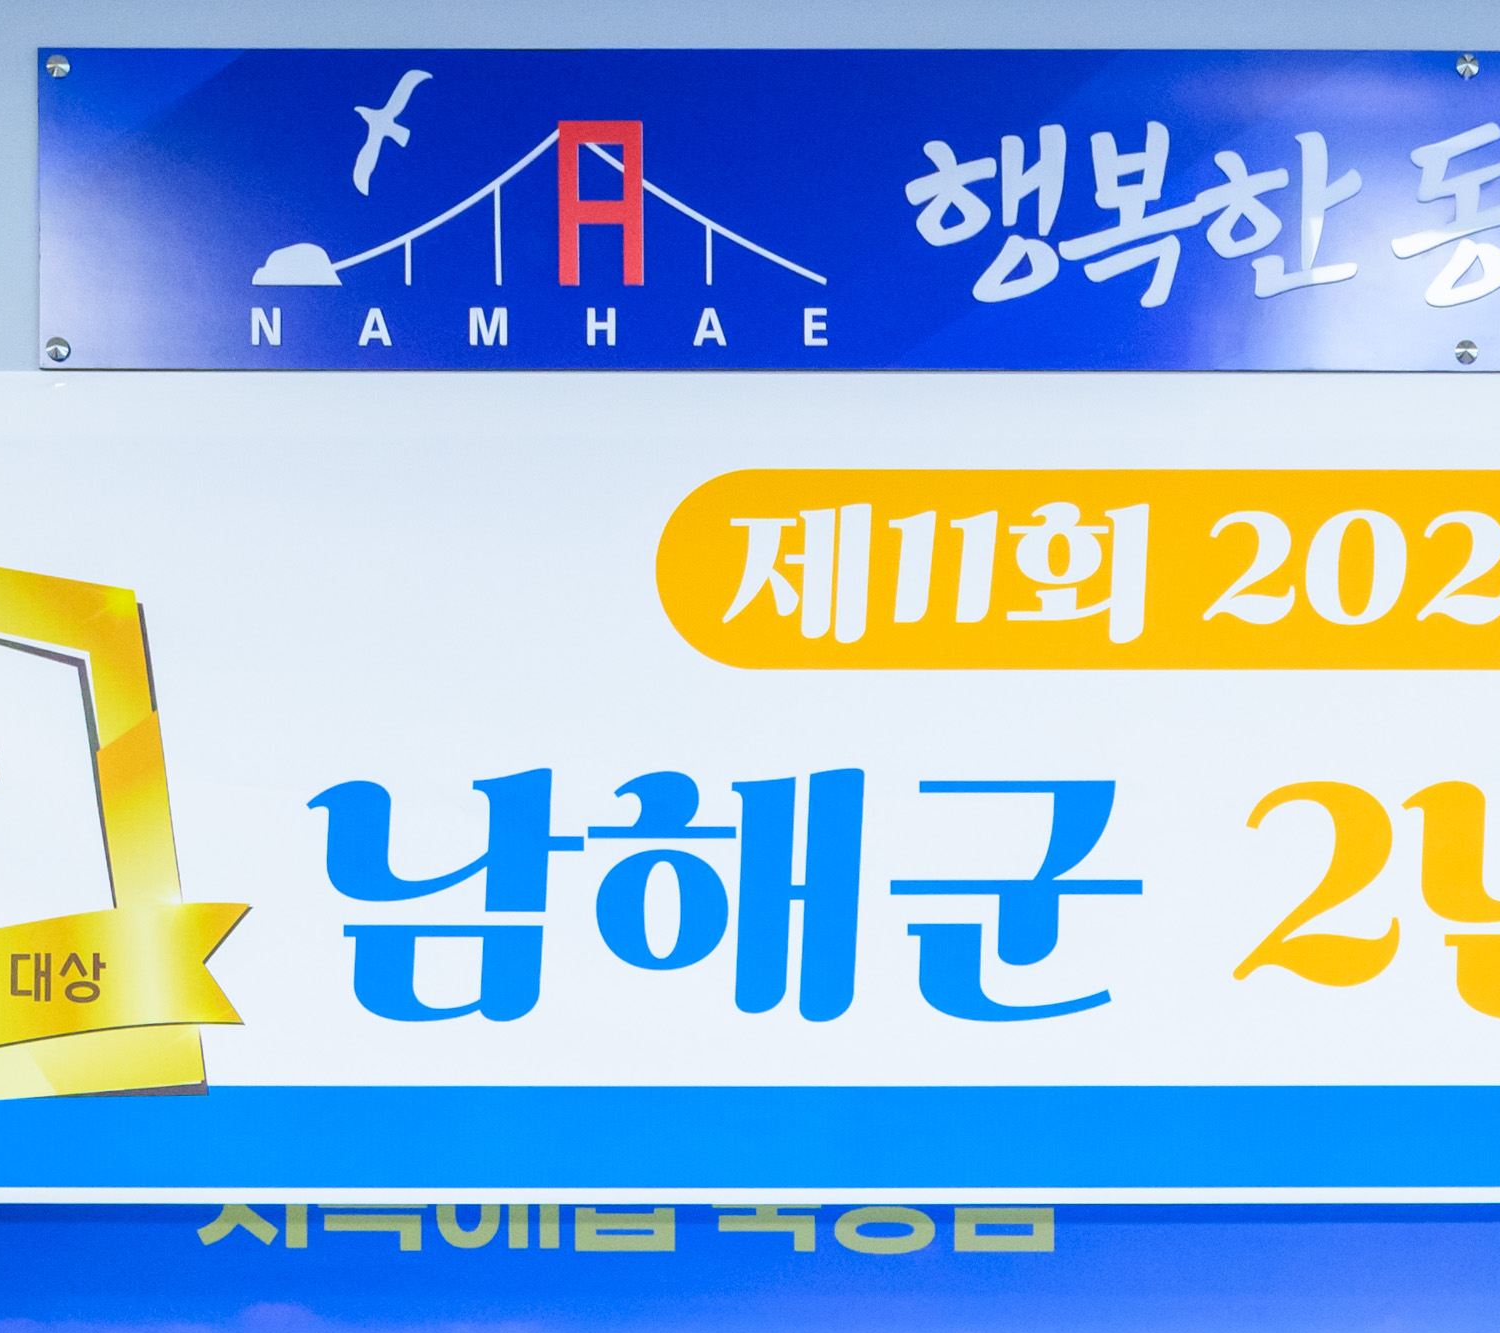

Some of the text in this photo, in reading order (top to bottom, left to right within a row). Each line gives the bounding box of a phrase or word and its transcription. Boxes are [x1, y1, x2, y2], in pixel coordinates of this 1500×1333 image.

[905, 120, 1363, 308] 행복한
[251, 306, 828, 348] NAMHAE
[722, 501, 1151, 643] 제11회
[305, 767, 1143, 1023] 남해군
[8, 950, 107, 1004] 대상
